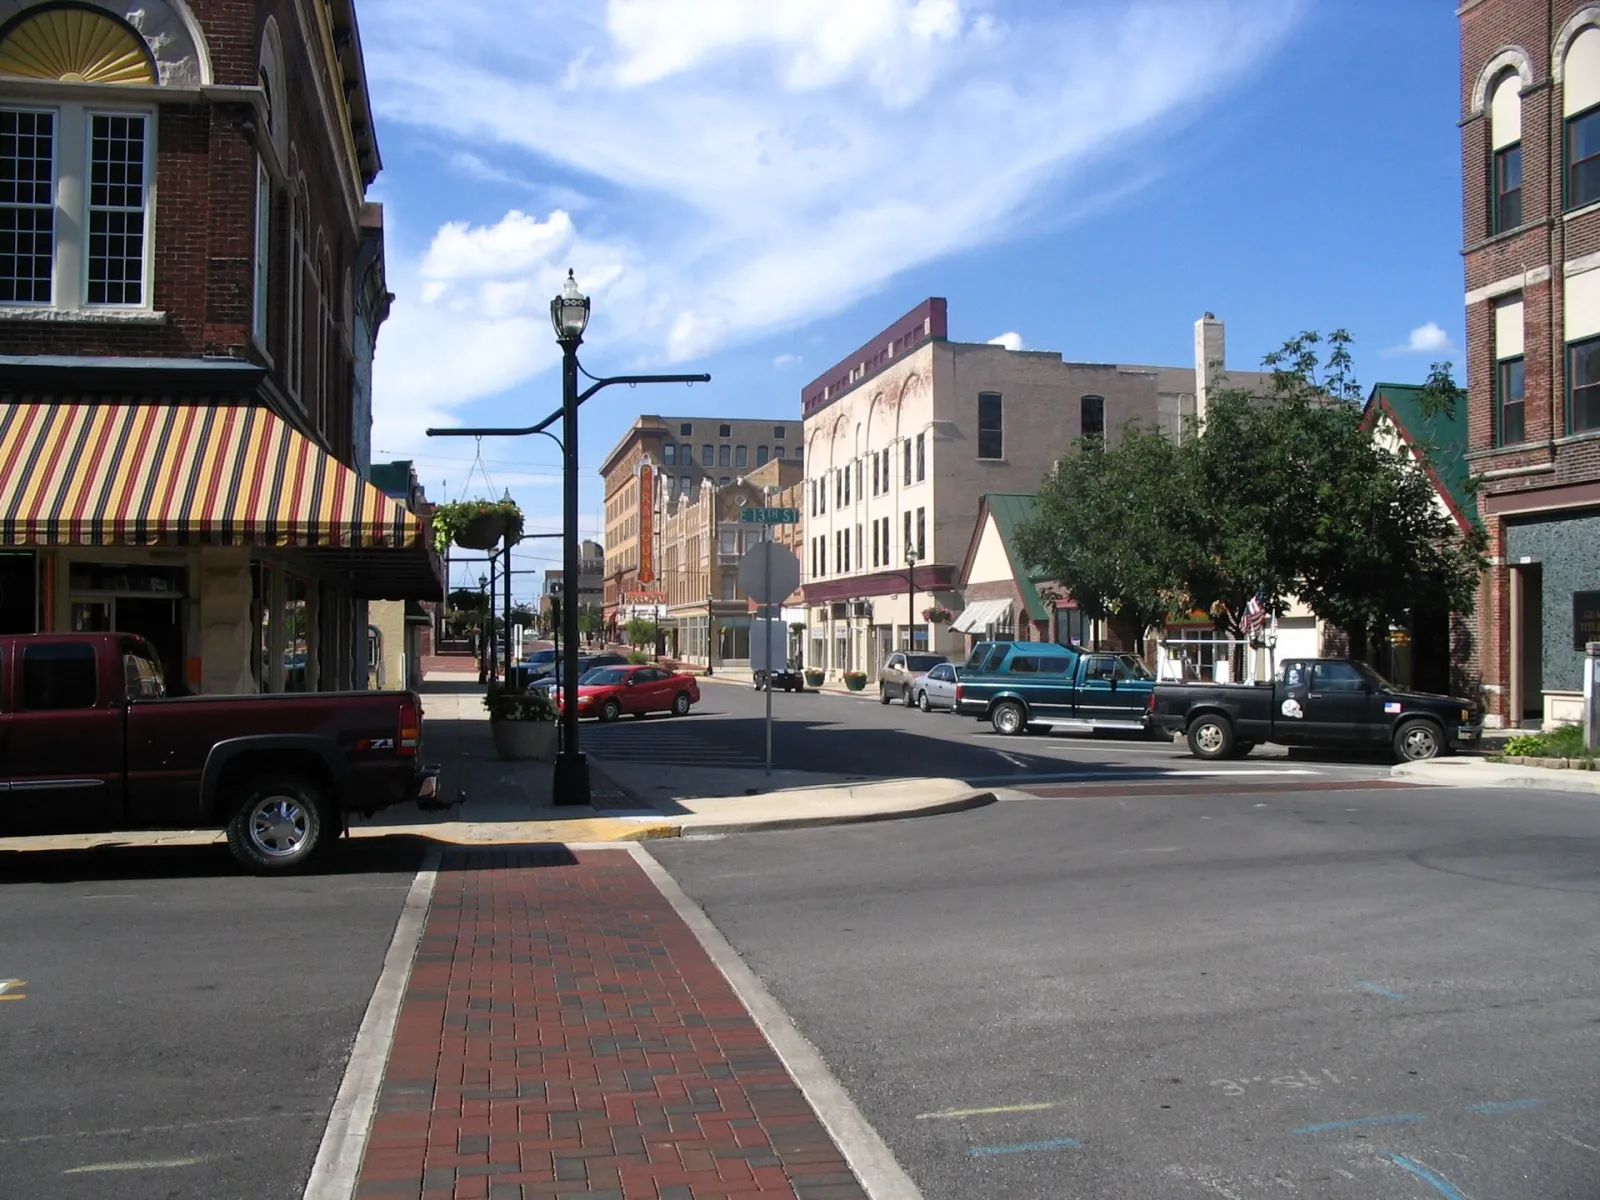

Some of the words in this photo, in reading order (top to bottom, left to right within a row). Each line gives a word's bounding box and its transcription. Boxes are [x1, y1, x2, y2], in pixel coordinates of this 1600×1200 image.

[740, 508, 747, 523] E
[752, 508, 778, 523] 13TH
[782, 508, 798, 523] ST
